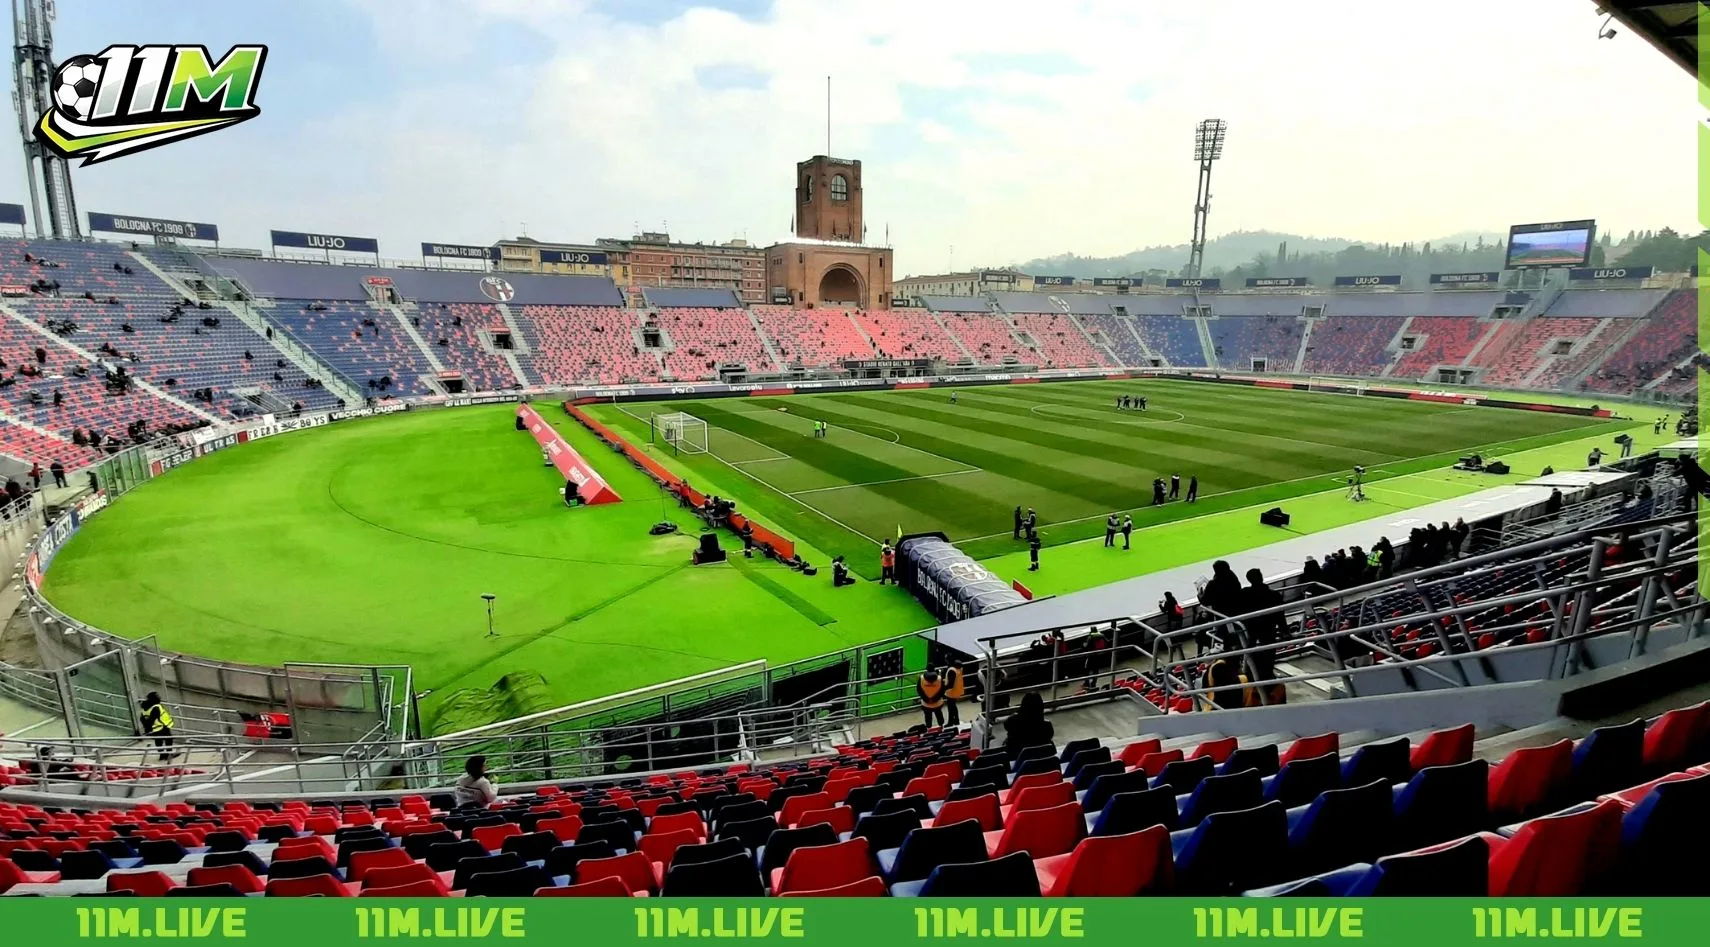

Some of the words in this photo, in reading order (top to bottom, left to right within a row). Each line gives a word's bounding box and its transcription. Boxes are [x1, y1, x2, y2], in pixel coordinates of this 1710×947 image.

[113, 219, 152, 232] BOLOGNA
[152, 222, 162, 233] FC
[163, 223, 184, 235] 1909
[433, 246, 460, 255] BOLOGNA
[332, 407, 373, 420] VECCHIO
[374, 403, 406, 415] CUORE
